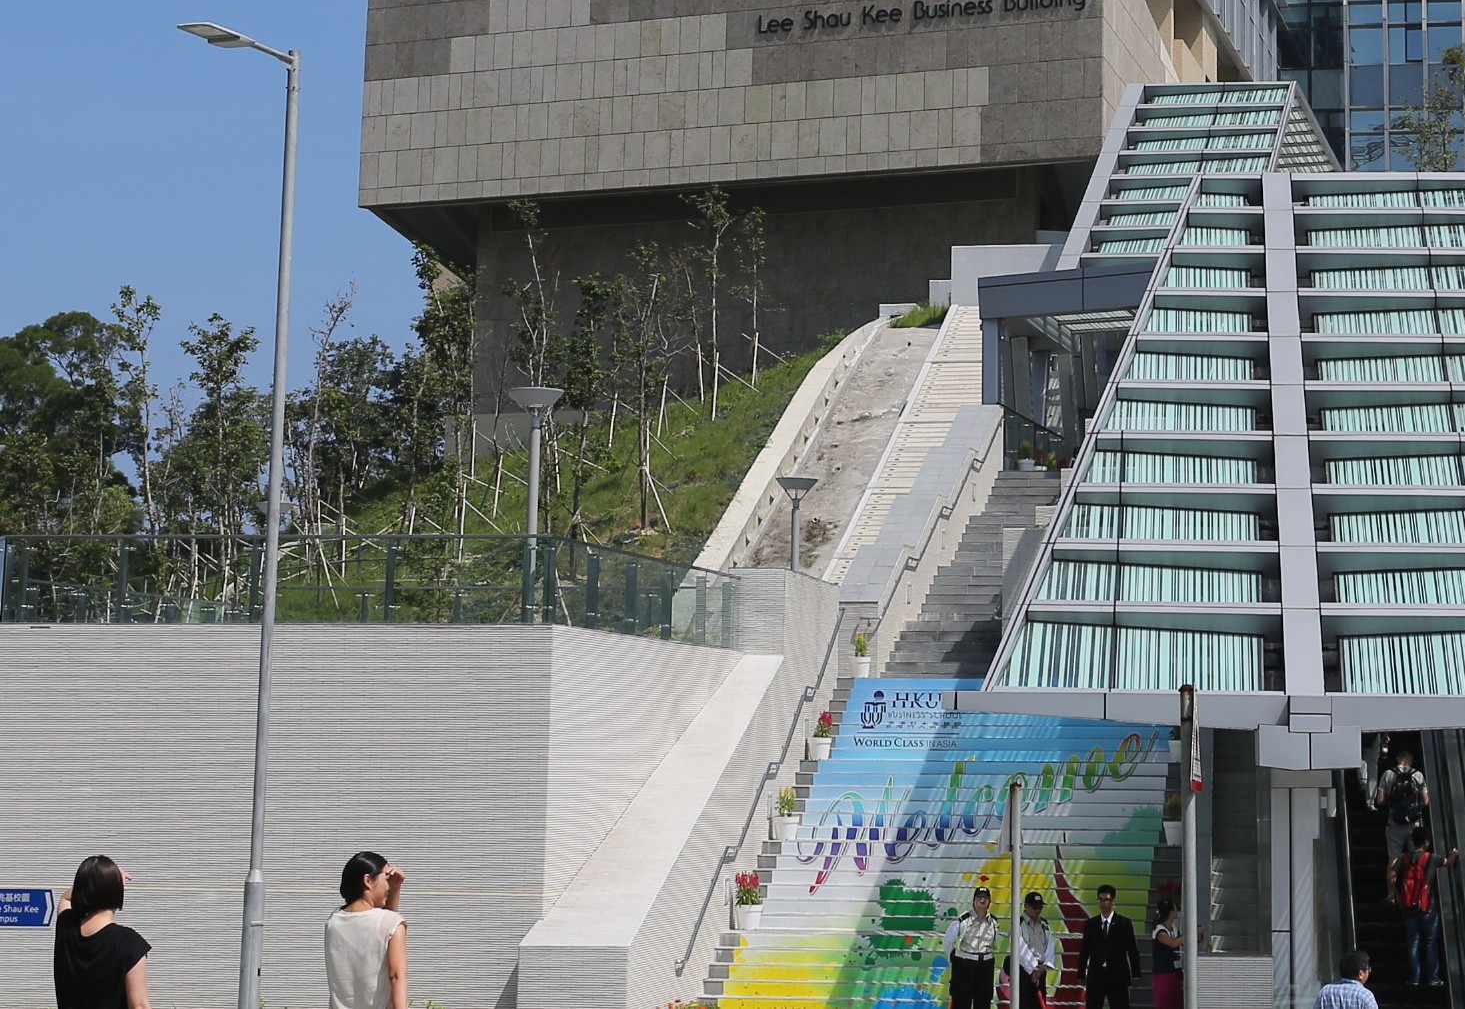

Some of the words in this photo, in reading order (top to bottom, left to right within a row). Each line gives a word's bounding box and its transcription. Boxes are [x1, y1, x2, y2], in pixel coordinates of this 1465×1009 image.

[757, 14, 794, 35] Lee
[803, 8, 852, 31] Shau
[862, 2, 902, 26] Kee
[854, 736, 892, 748] WORLD
[894, 738, 924, 748] CLASS
[926, 740, 936, 748] IN
[937, 740, 957, 748] ASIA
[3, 904, 22, 912] Shau
[25, 905, 39, 913] Kee
